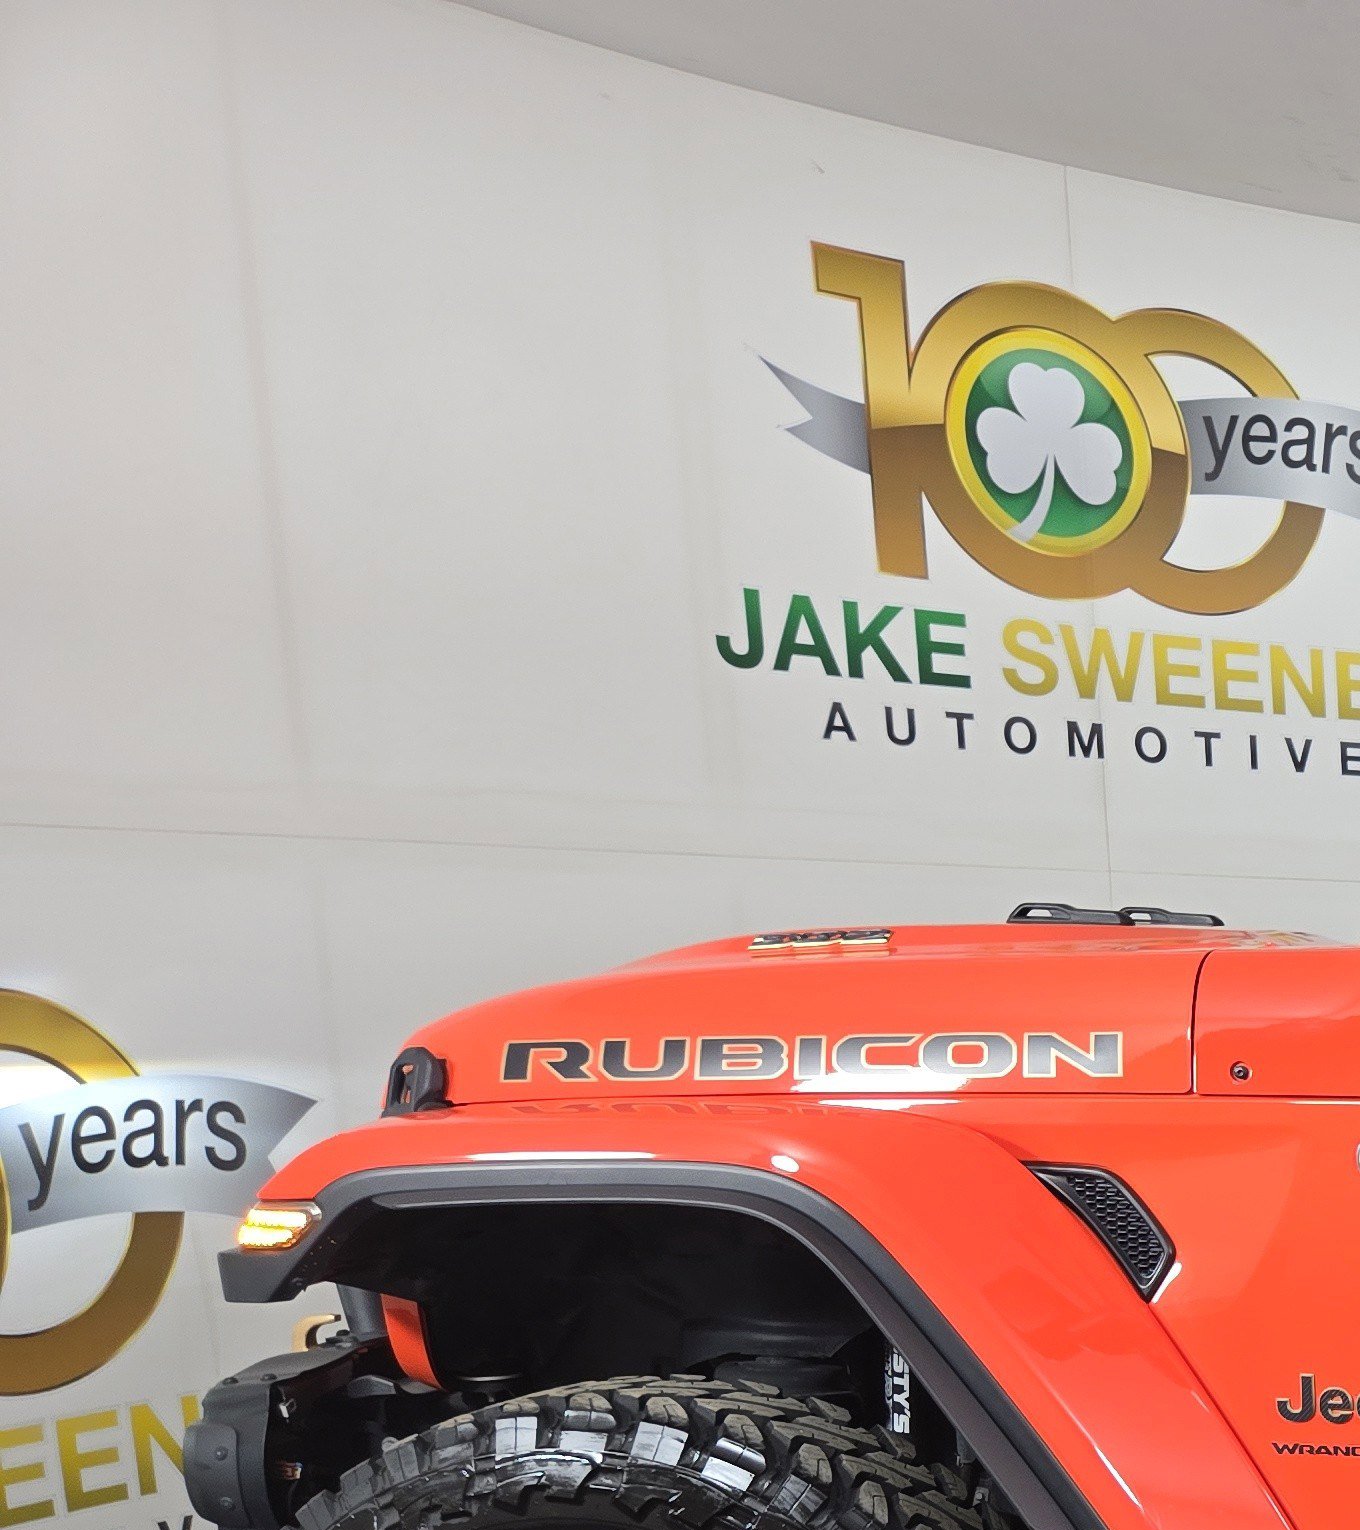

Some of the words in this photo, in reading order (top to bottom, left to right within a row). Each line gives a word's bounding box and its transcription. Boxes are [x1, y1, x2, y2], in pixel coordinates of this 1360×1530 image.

[715, 587, 972, 690] JAKE
[498, 1031, 1125, 1083] RUBICON
[18, 1097, 248, 1212] years
[892, 1347, 911, 1435] STY'S
